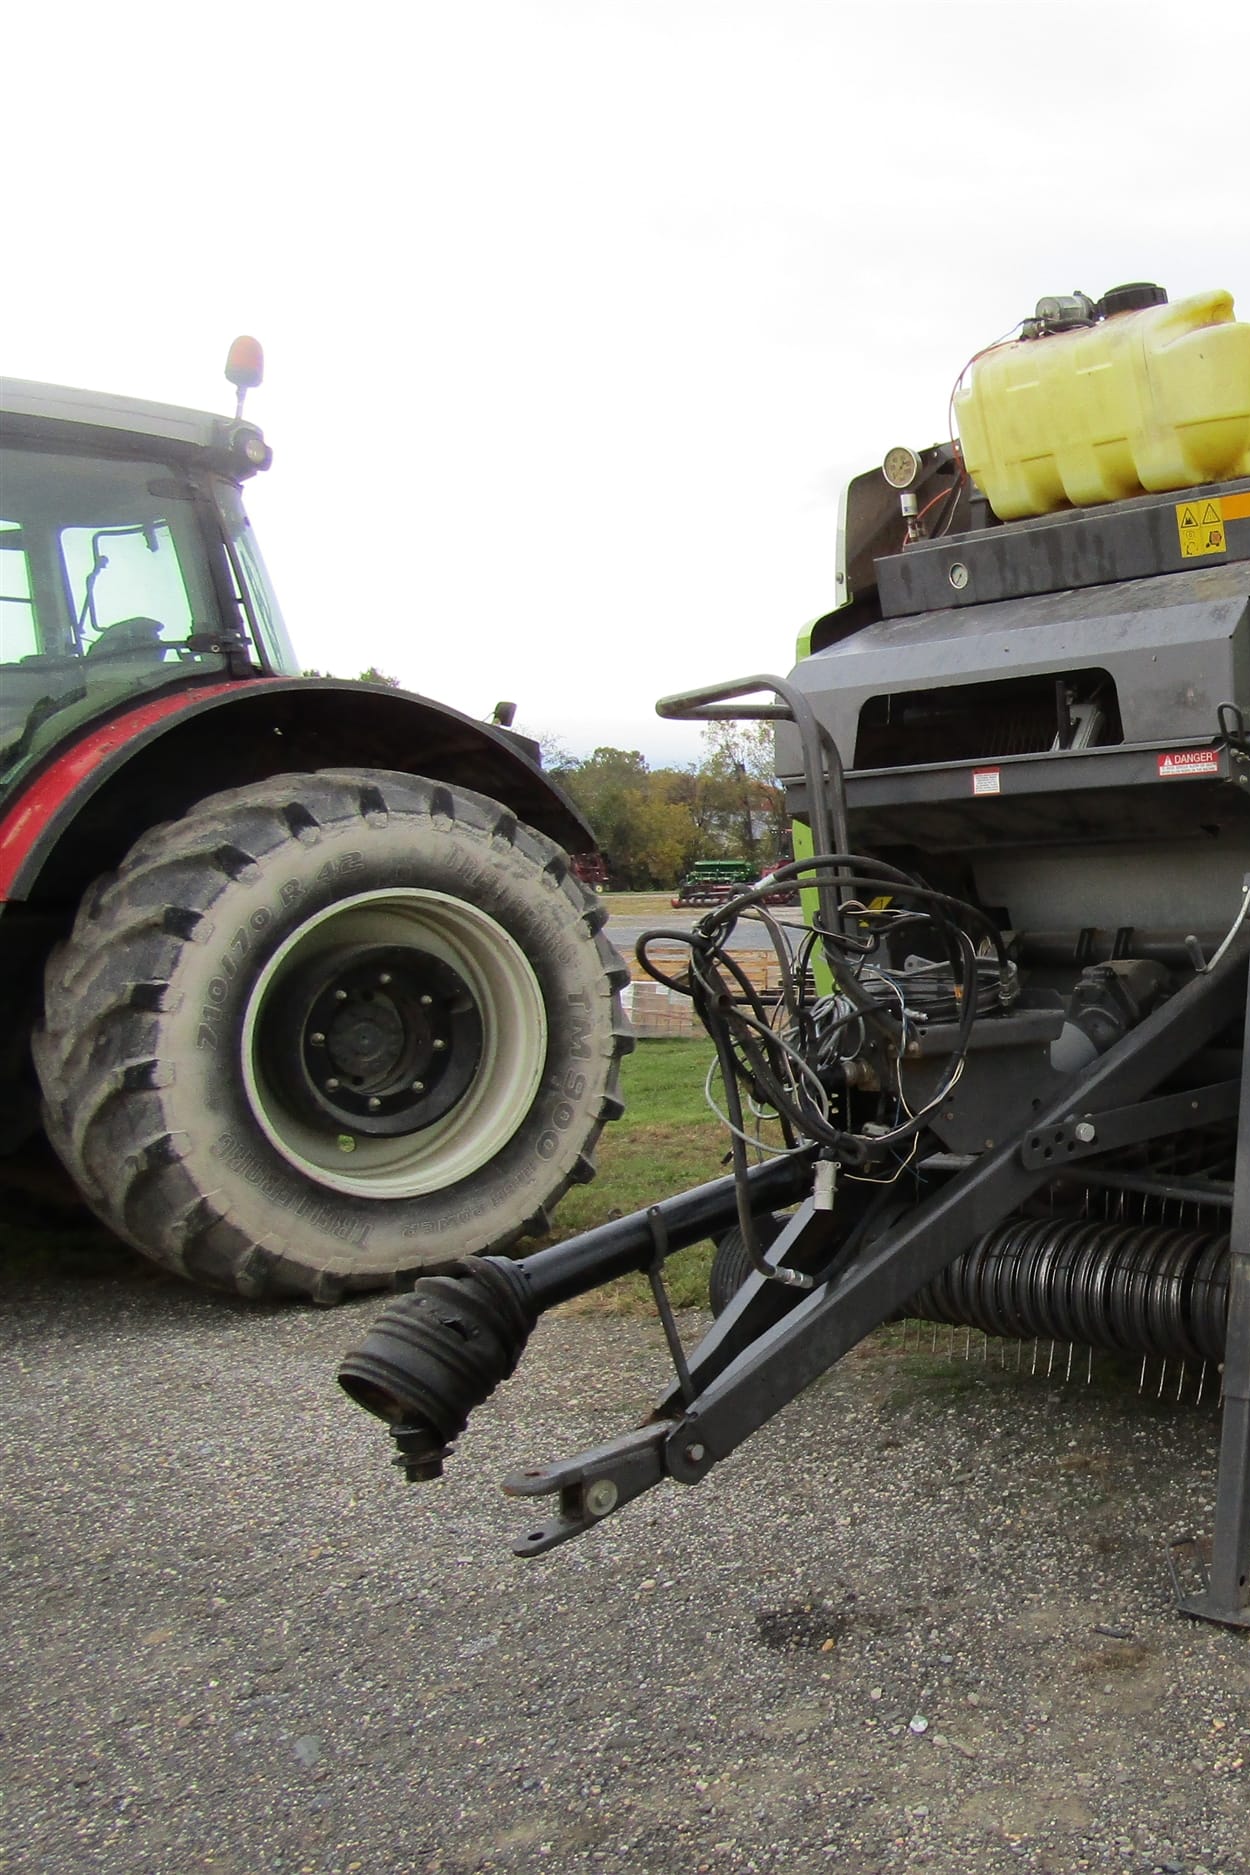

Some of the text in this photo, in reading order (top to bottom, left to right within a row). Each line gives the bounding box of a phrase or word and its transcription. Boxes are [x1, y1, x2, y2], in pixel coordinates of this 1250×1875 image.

[1174, 752, 1213, 764] DANGER
[196, 850, 367, 1050] 710/70 R 42
